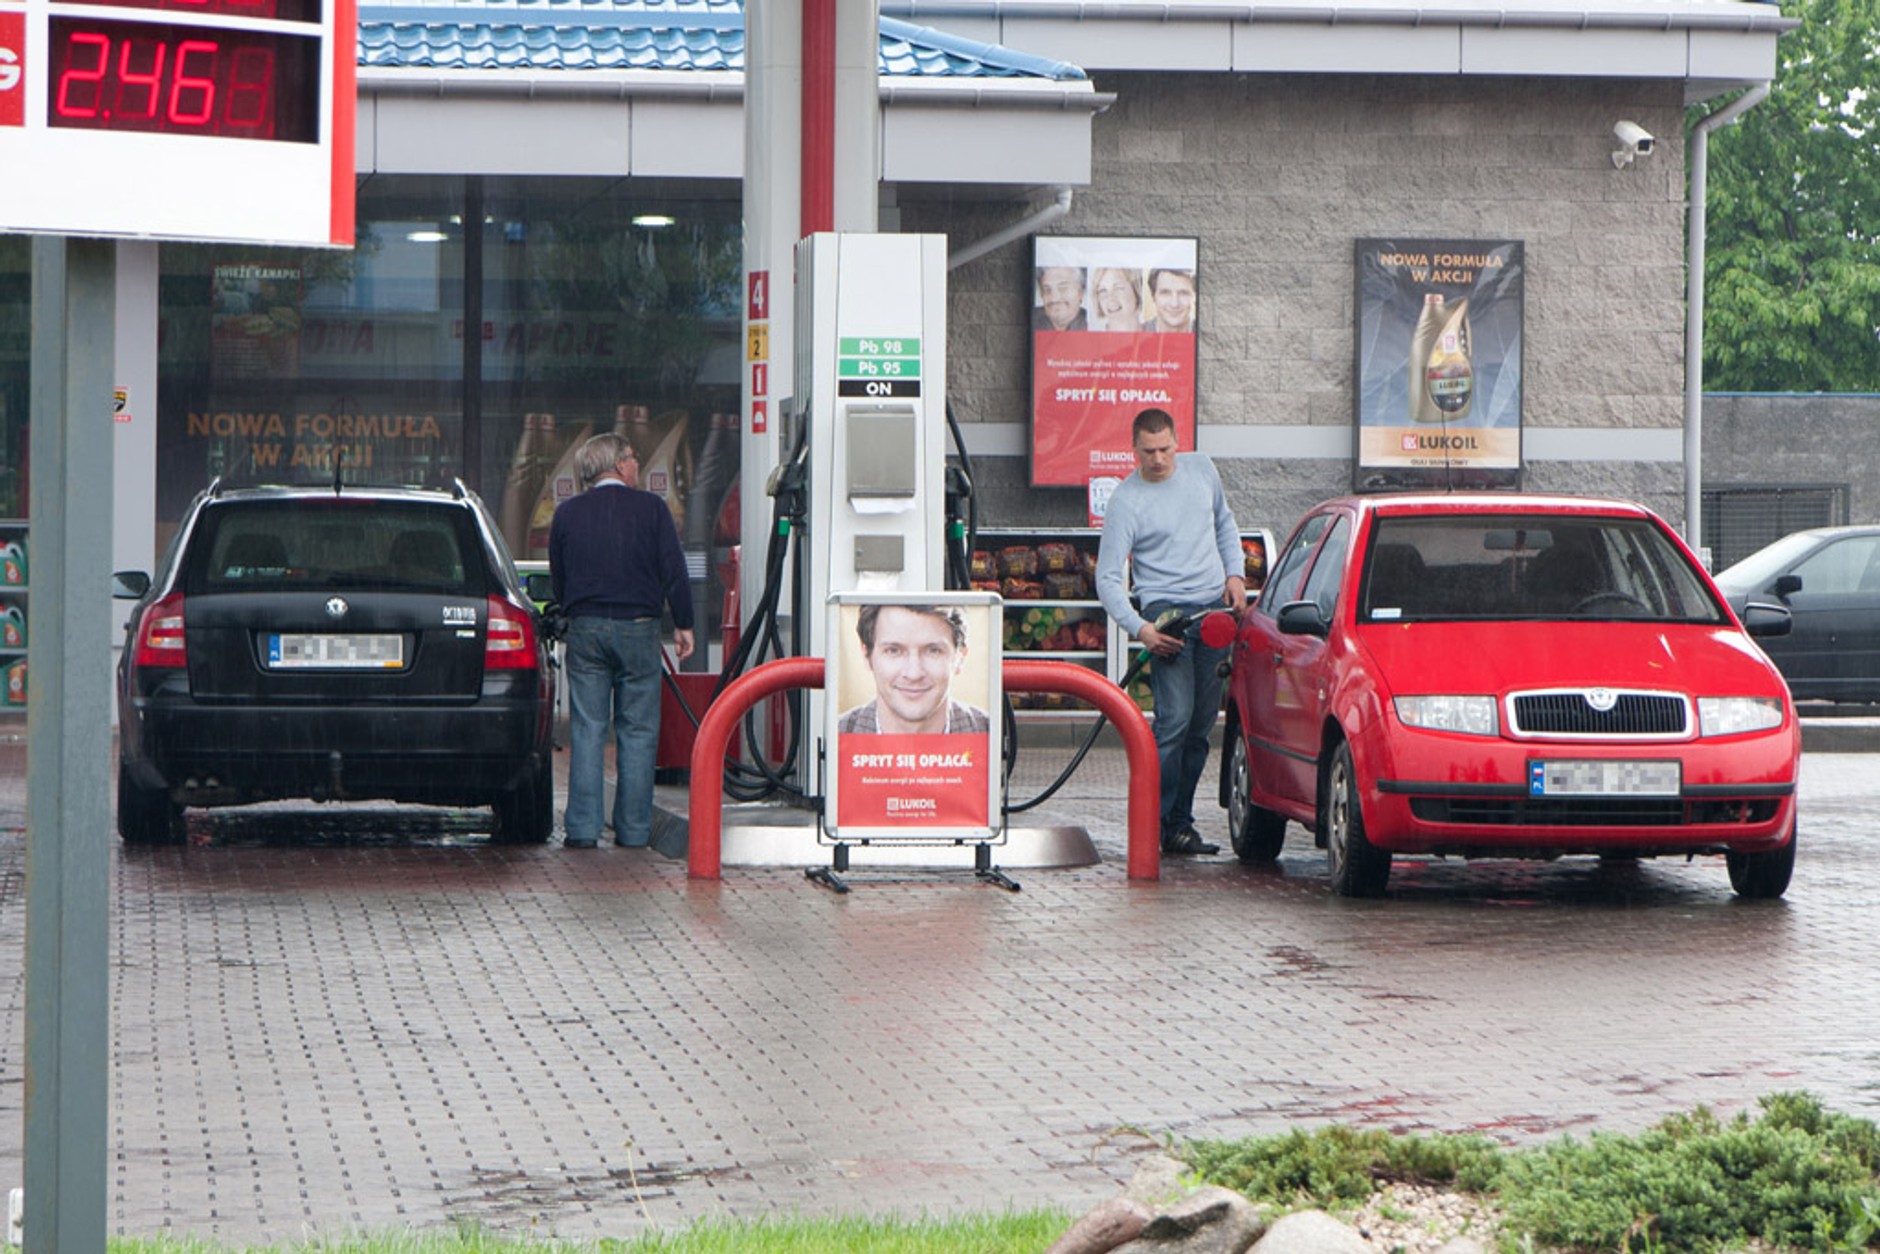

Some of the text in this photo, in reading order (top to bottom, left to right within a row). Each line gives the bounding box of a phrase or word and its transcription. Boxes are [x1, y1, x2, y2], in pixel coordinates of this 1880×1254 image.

[1380, 253, 1503, 268] NOWA FORMUŁA
[1411, 270, 1473, 283] W AKCJI
[752, 279, 764, 311] 4
[858, 340, 903, 354] Pb 98
[858, 361, 901, 375] Pb 95
[866, 382, 892, 396] ON
[1055, 388, 1096, 403] SPRYT
[1098, 389, 1116, 405] SIĘ
[187, 412, 441, 439] NOWA FORMUŁA
[1419, 434, 1478, 450] LUKOIL
[252, 443, 373, 468] W AKCJI
[1101, 452, 1136, 462] LUKOIL
[852, 754, 893, 768] SPRYT
[896, 754, 916, 770] SIĘ
[900, 798, 937, 810] LUKOIL
